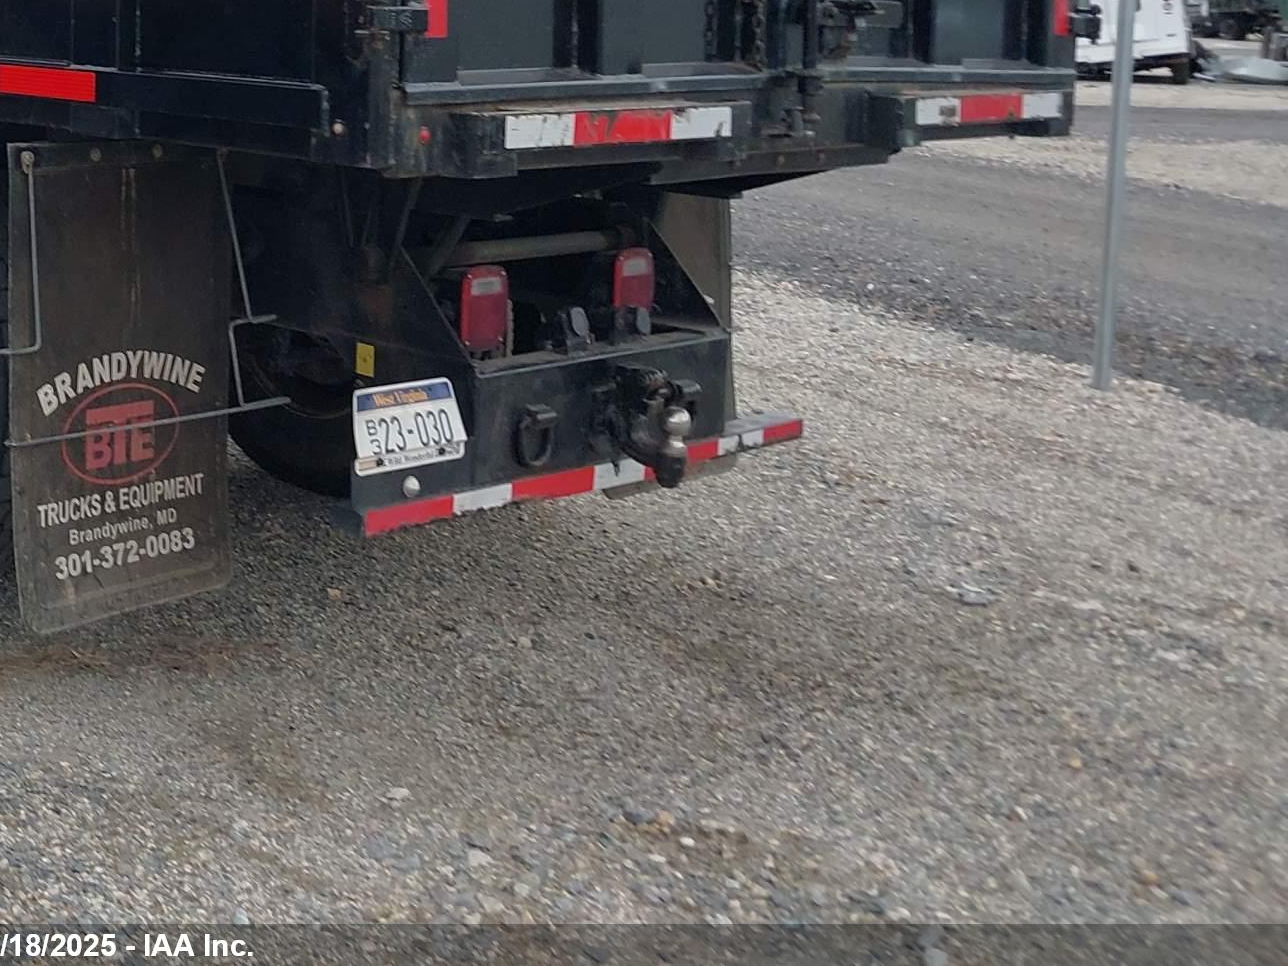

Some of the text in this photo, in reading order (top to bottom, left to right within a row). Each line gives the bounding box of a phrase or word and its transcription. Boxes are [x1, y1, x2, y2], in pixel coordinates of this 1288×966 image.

[35, 350, 207, 417] BRANDYWINE
[85, 399, 155, 471] BTE
[378, 408, 454, 454] 23-030
[37, 473, 204, 528] TRUCKS & EQUIPMENT
[69, 508, 177, 545] Brandywine, MD
[55, 527, 195, 580] 301-372-0083
